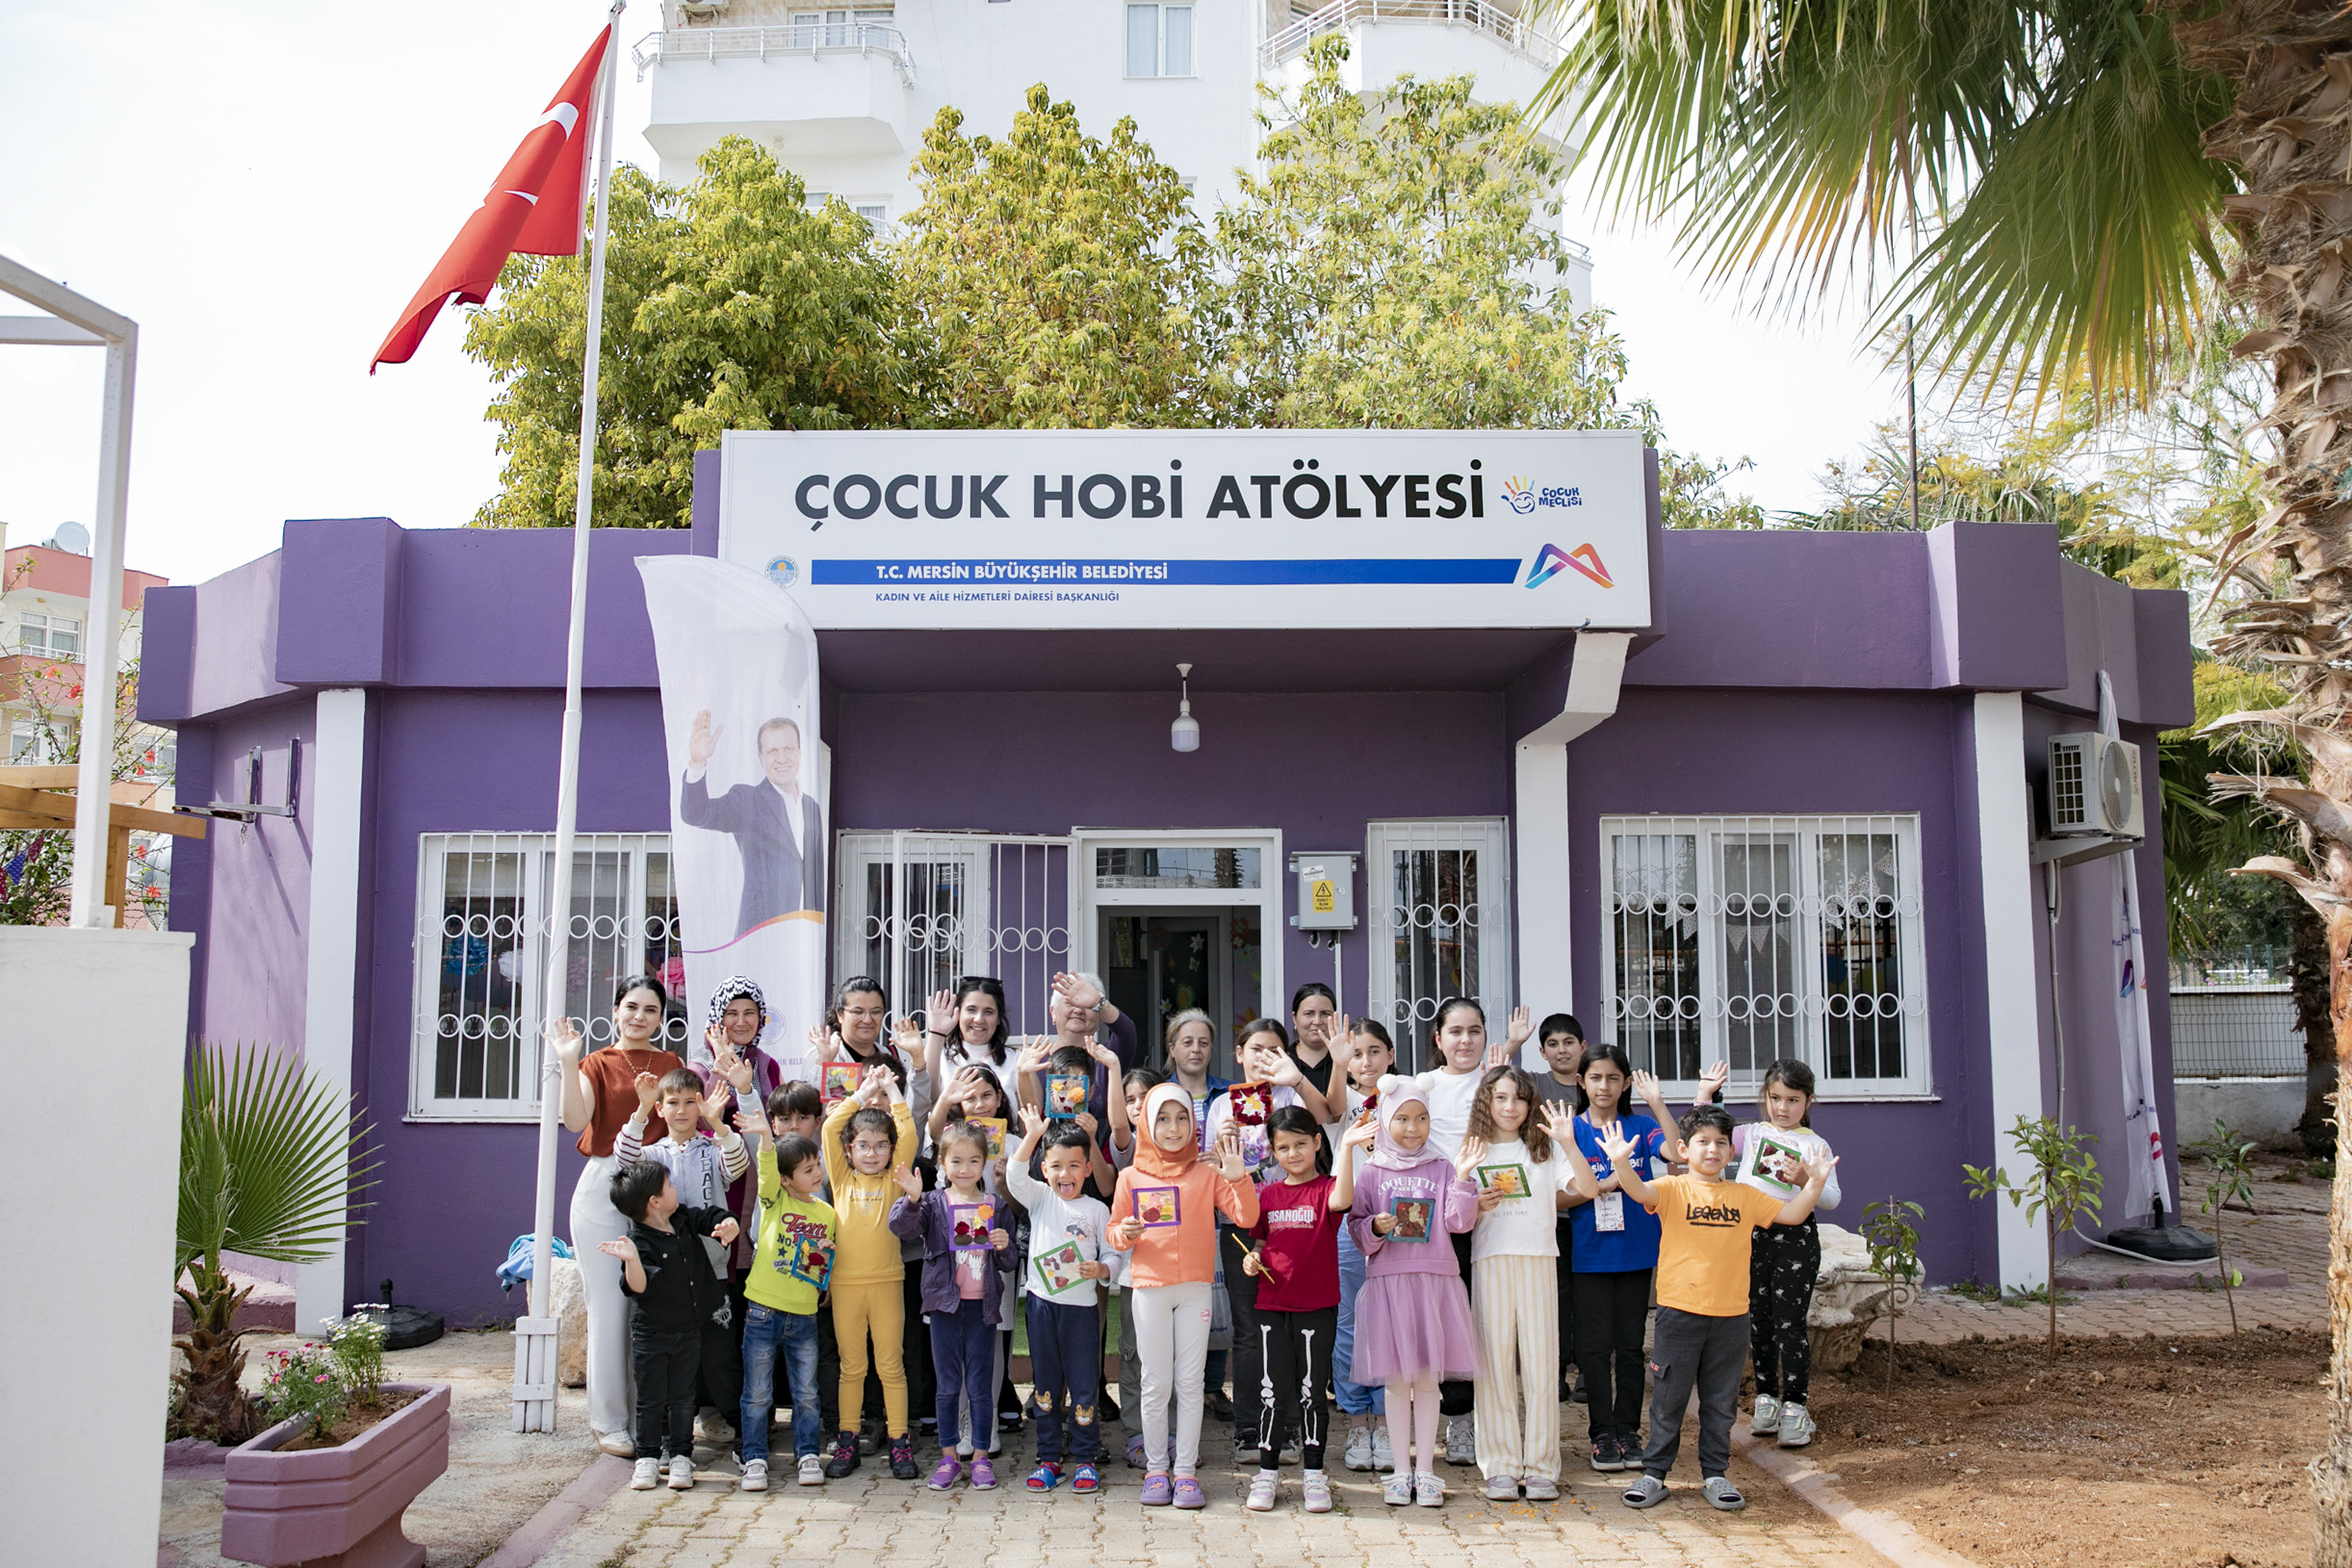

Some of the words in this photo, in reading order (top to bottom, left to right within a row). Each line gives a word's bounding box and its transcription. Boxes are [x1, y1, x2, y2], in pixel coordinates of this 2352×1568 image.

[795, 474, 1010, 532] ÇOCUK
[1033, 458, 1183, 519] HOBİ
[1205, 458, 1485, 520] ATÖLYESİ
[876, 565, 904, 579] T.C.
[907, 561, 969, 579] MERSİN
[974, 561, 1078, 582] BÜYÜKŞEHİR
[1082, 561, 1168, 579] BELEDİYESİ
[875, 593, 910, 602] KADIN
[913, 593, 925, 602] VE
[928, 590, 950, 602] AİLE
[953, 590, 1011, 602] HİZMETLERİ
[1014, 590, 1053, 602] DAİRESİ
[1056, 590, 1120, 604] BAŞKANLIĞI
[1686, 1203, 1742, 1223] LEGENDS
[781, 1212, 827, 1238] Team
